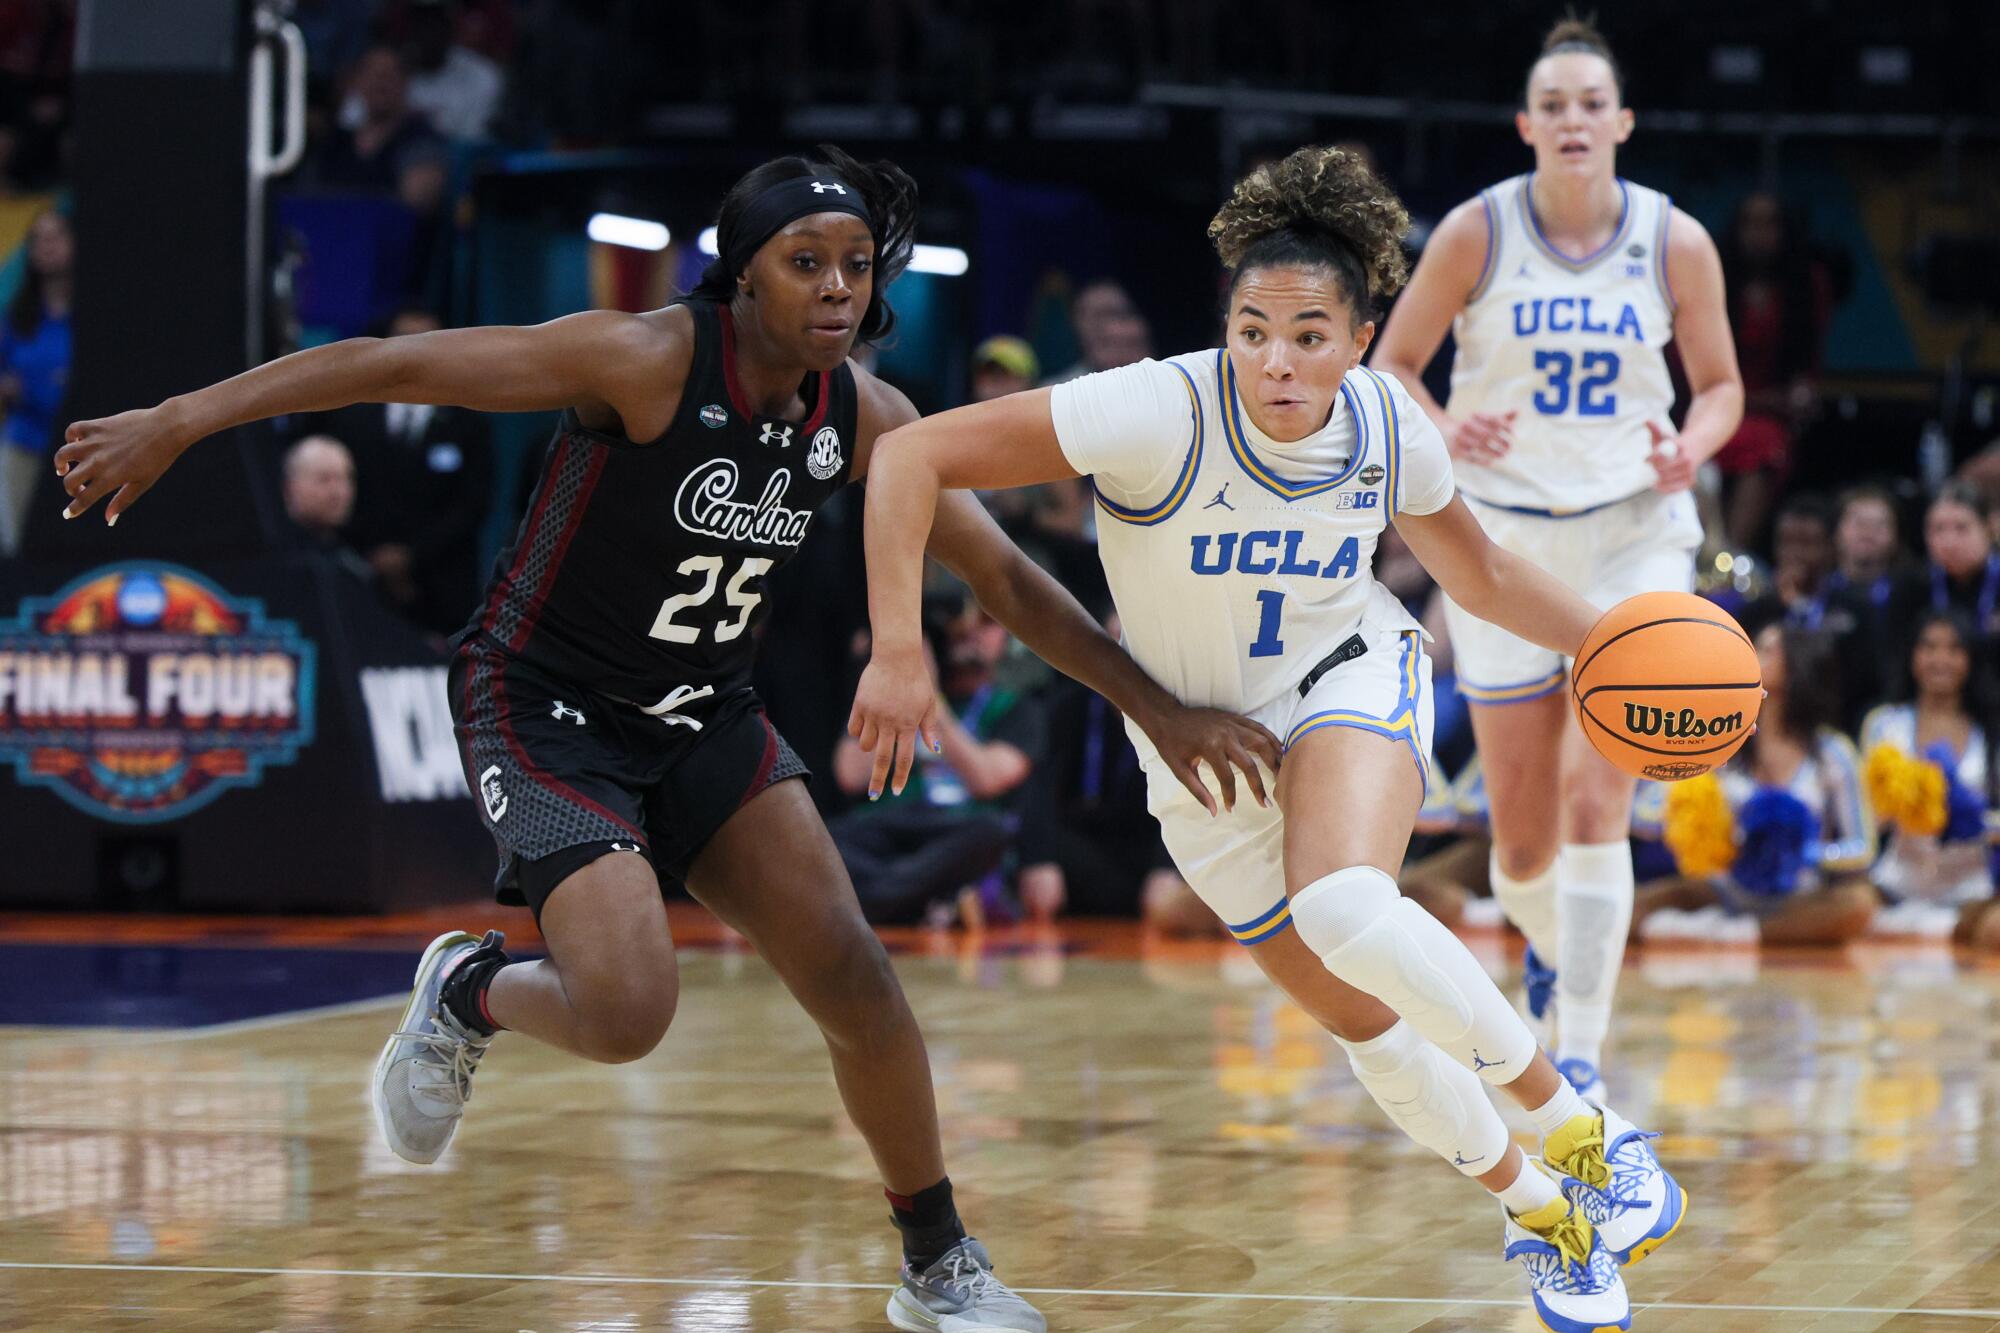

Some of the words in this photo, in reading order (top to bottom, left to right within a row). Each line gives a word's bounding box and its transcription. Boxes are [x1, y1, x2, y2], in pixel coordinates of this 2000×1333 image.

[1513, 297, 1645, 342] UCLA
[1534, 350, 1621, 416] 32
[814, 429, 838, 468] SEC
[674, 457, 813, 546] Carolina
[1336, 491, 1378, 510] BIG
[1190, 530, 1359, 579] UCLA
[648, 555, 774, 645] 25
[1249, 589, 1285, 658] 1
[1348, 644, 1362, 657] 42
[146, 650, 295, 719] FOUR
[1623, 702, 1743, 739] Wilson
